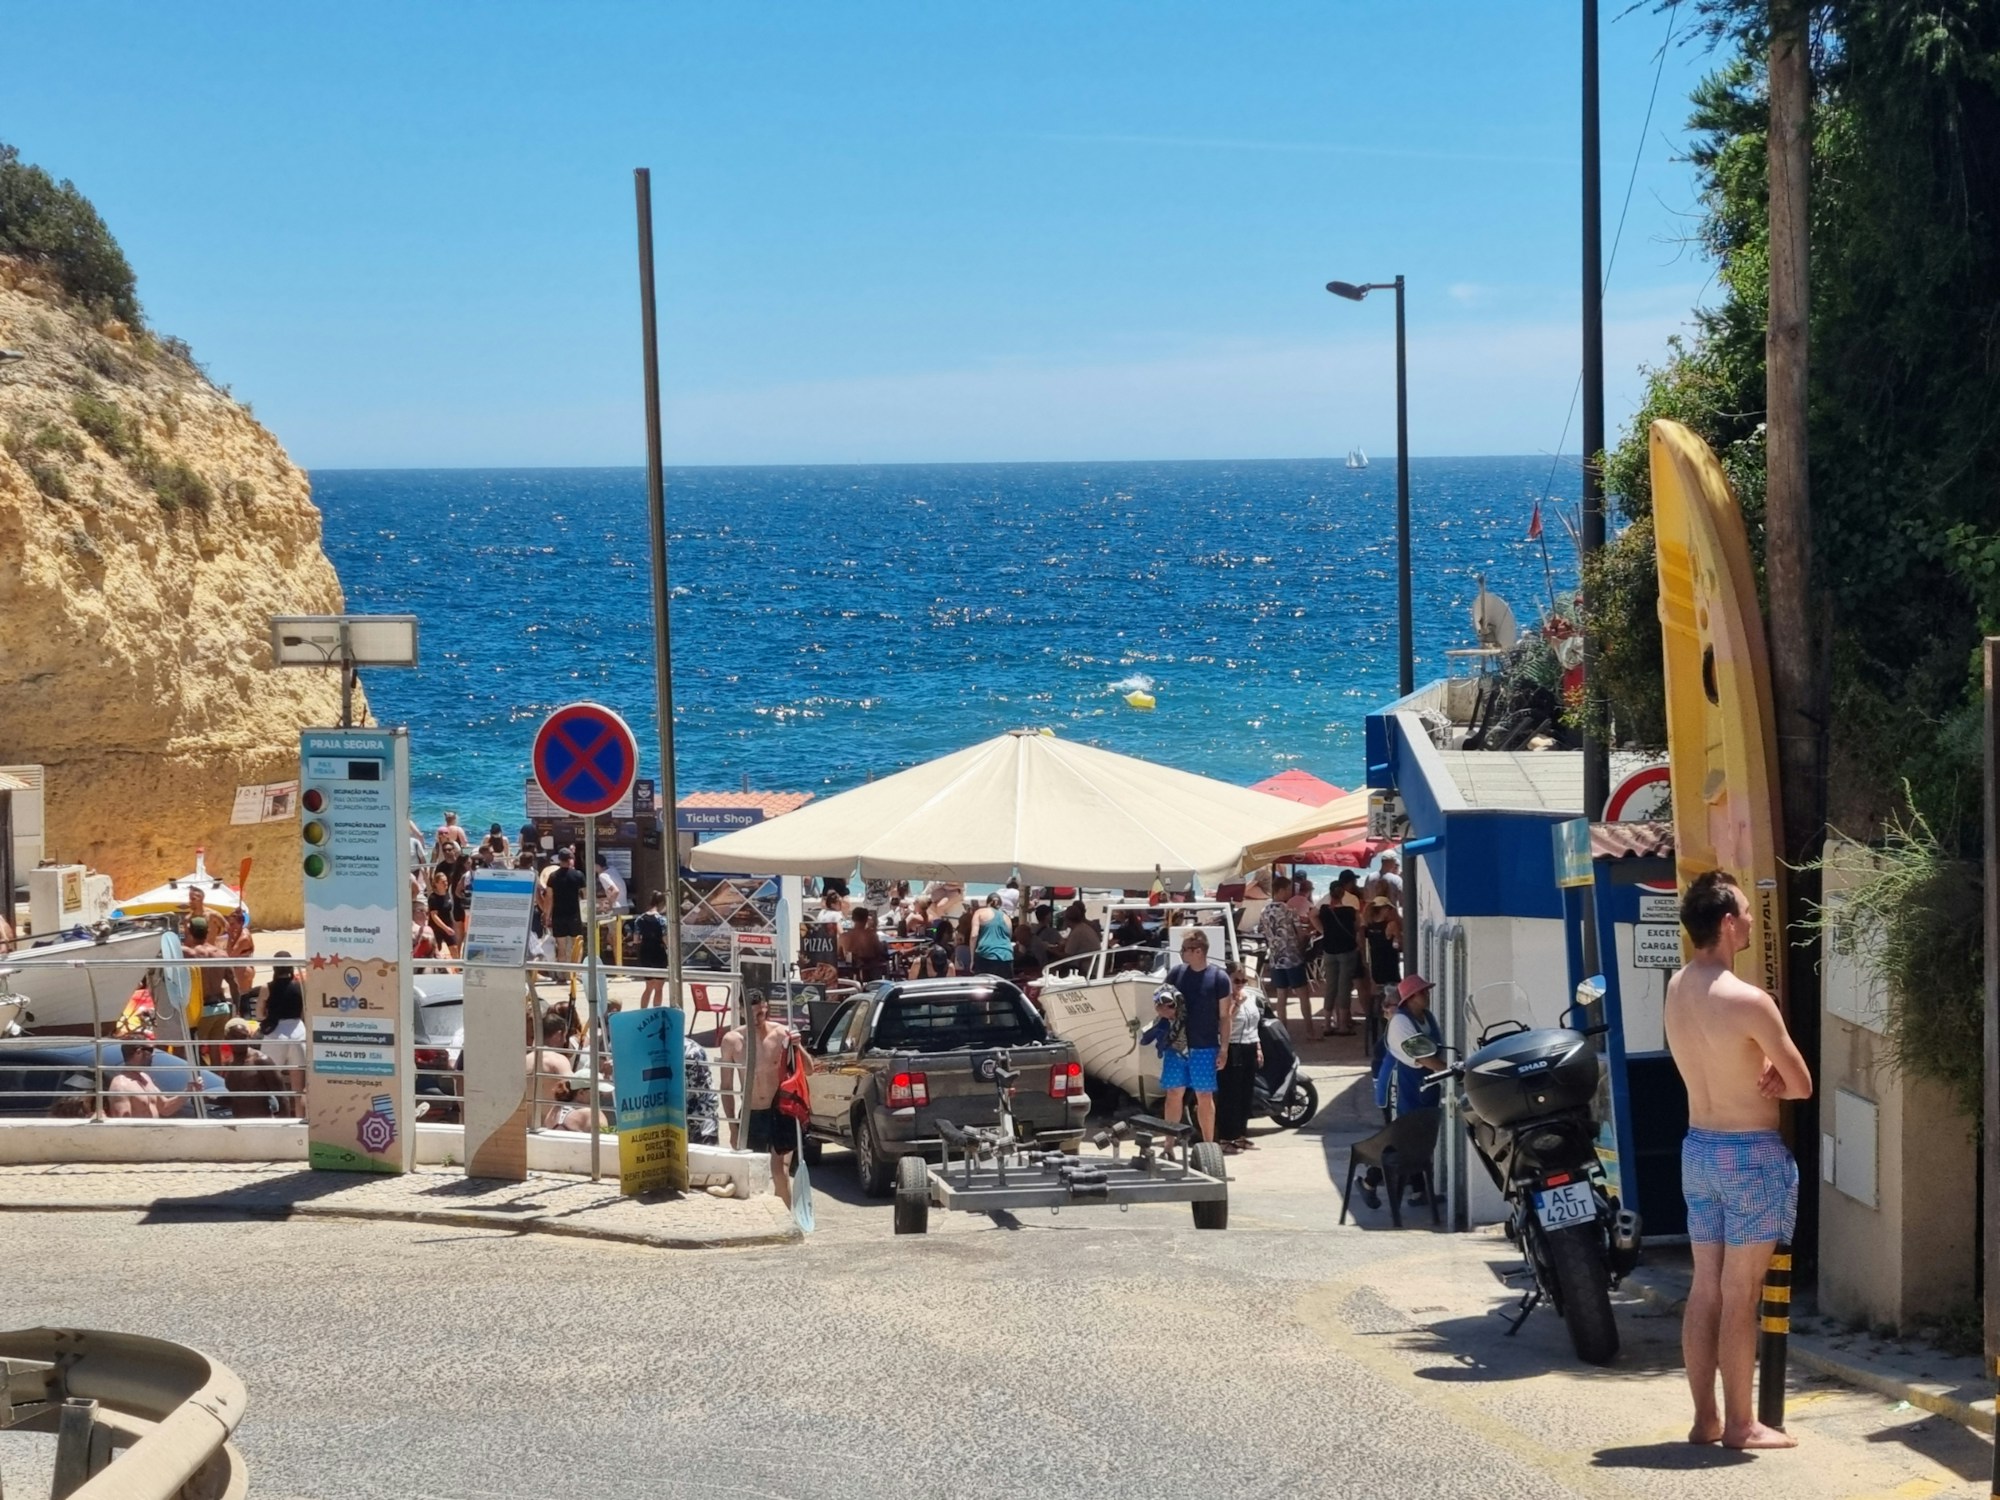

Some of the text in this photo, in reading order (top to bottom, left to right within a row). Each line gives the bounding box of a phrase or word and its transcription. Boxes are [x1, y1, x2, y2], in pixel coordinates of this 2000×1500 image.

[310, 739, 384, 750] PRAIA SEGURA
[686, 814, 752, 825] Ticket Shop
[598, 828, 616, 836] SHOP
[354, 926, 380, 935] Benagil
[804, 938, 834, 952] PIZZAS
[1762, 892, 1774, 990] WATERFALL
[322, 993, 368, 1012] Lagoa
[637, 1012, 660, 1032] KAYAK
[1518, 1061, 1548, 1072] SHAD
[631, 1131, 659, 1143] ALUGUER
[646, 1152, 666, 1162] PRAIA
[1552, 1187, 1578, 1206] AE
[1547, 1200, 1588, 1222] 42UT
